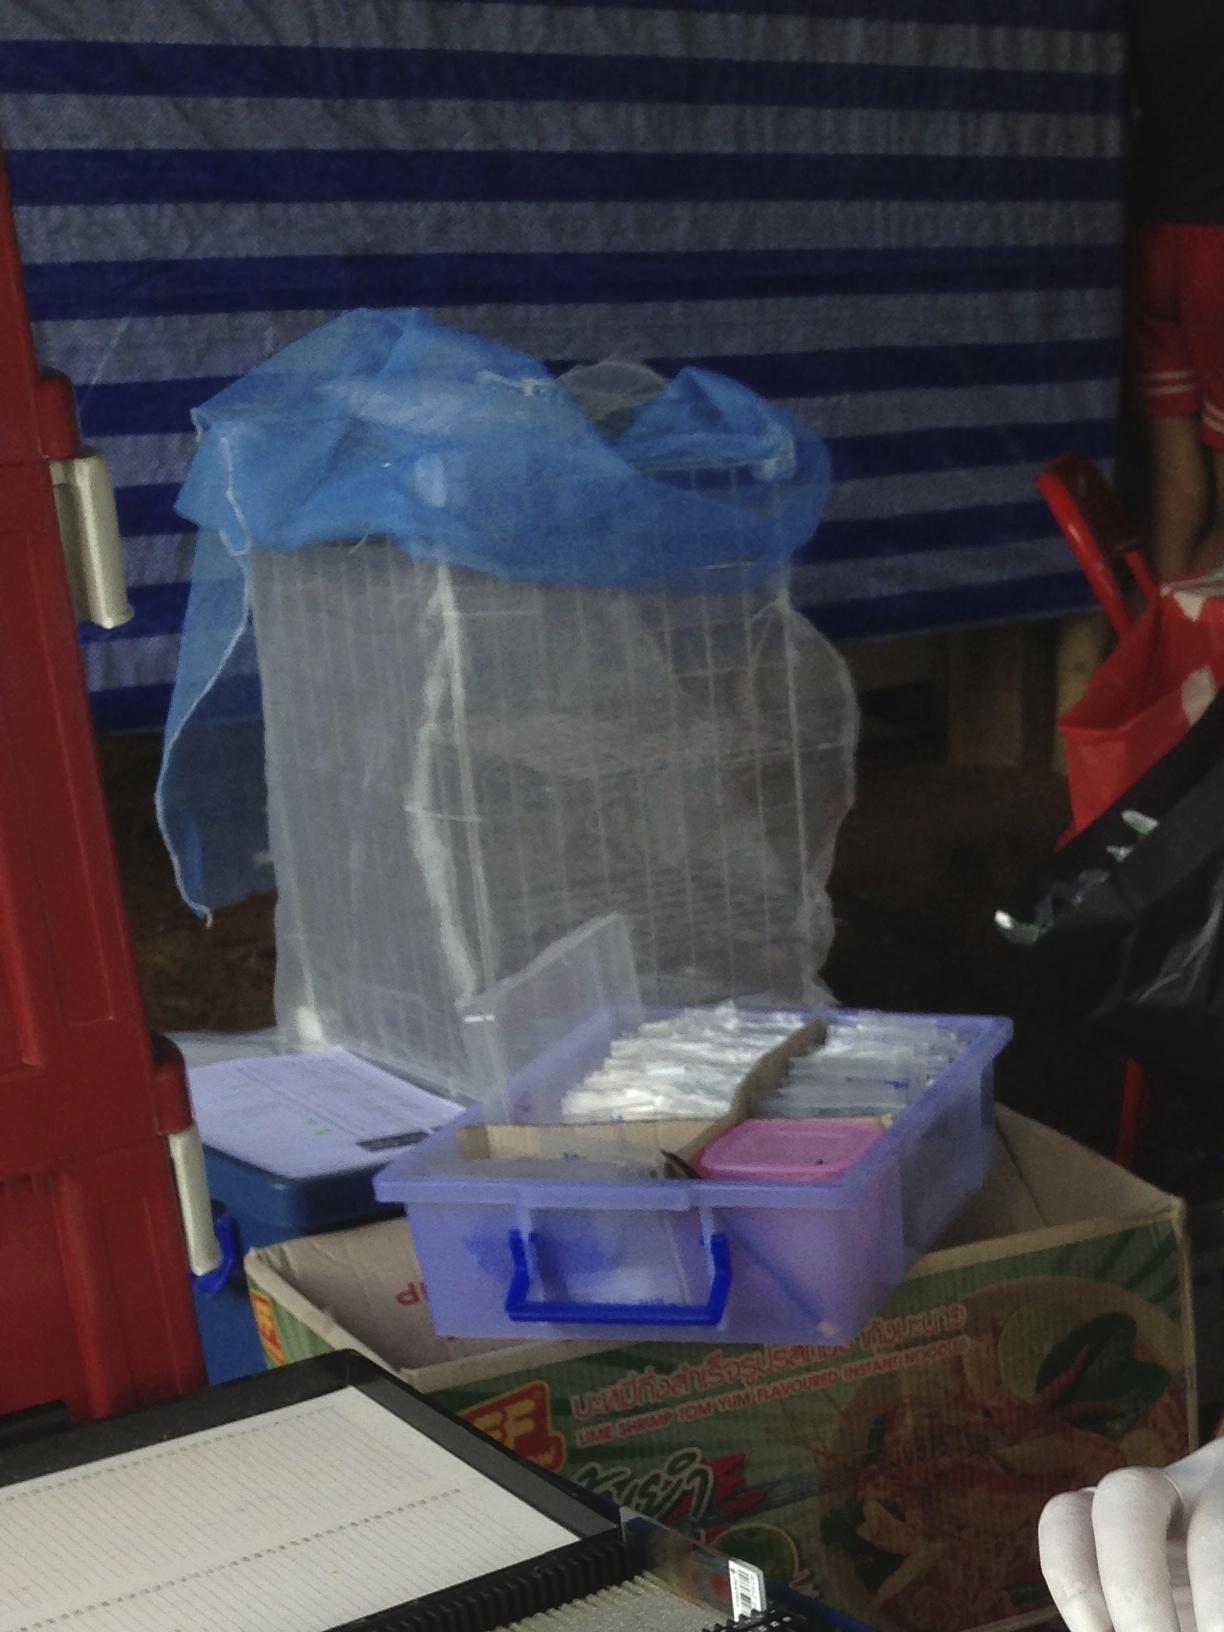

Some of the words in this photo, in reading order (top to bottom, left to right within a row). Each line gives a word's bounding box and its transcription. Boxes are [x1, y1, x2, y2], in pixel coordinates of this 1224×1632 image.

[577, 1422, 613, 1447] LIME
[618, 1409, 672, 1437] SHRIMP
[677, 1401, 712, 1422] TOM
[716, 1389, 751, 1412] YUM
[755, 1368, 839, 1403] FLAVOURED
[842, 1352, 898, 1381] INSTANT
[903, 1336, 970, 1365] NOODLES
